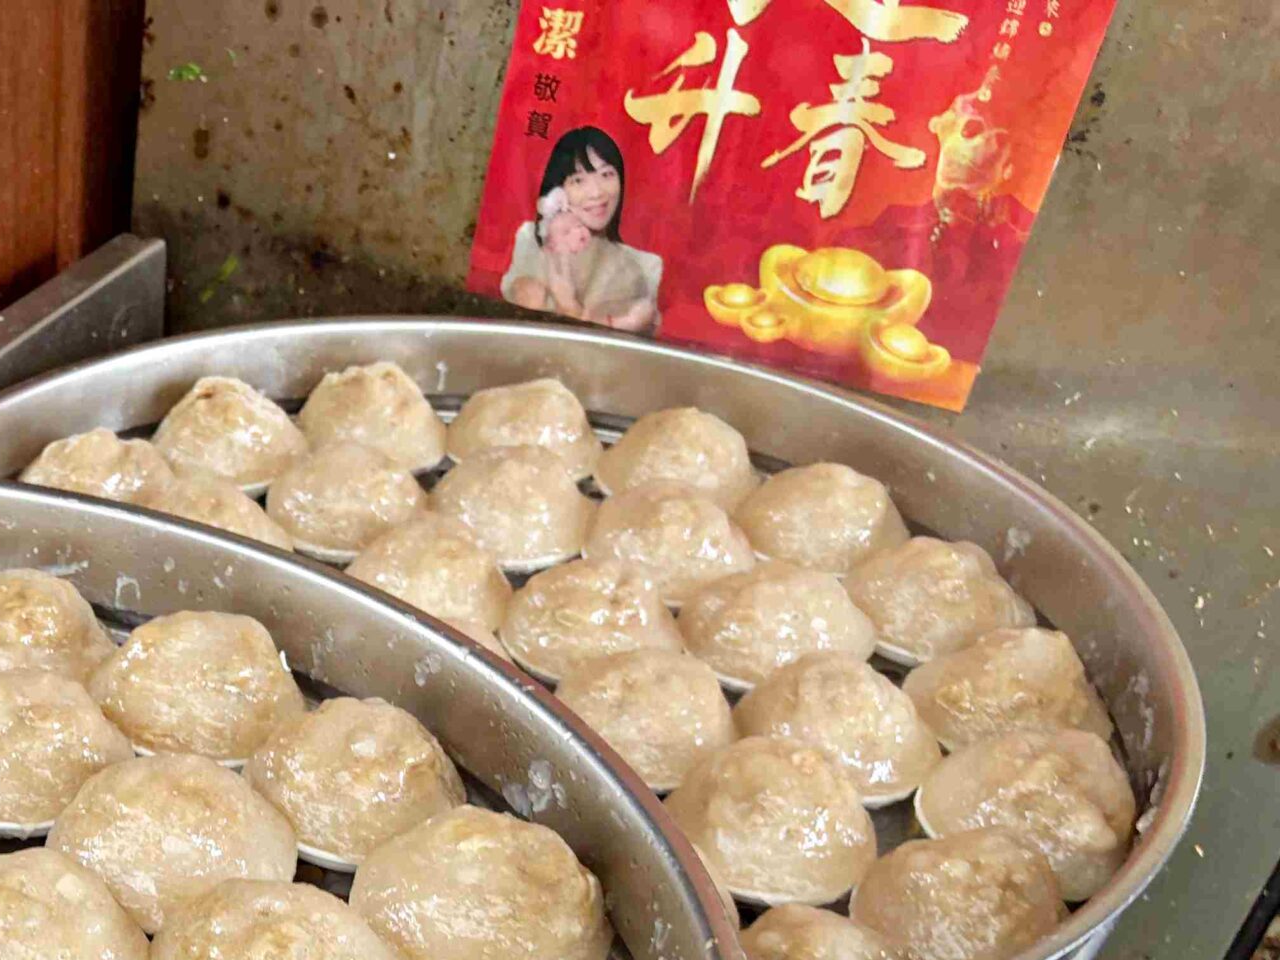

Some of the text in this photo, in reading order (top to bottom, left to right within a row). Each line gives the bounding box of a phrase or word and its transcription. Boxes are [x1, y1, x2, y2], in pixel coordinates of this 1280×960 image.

[524, 6, 585, 140] 潔 敬賀
[624, 0, 768, 206] 升
[760, 0, 969, 219] 春
